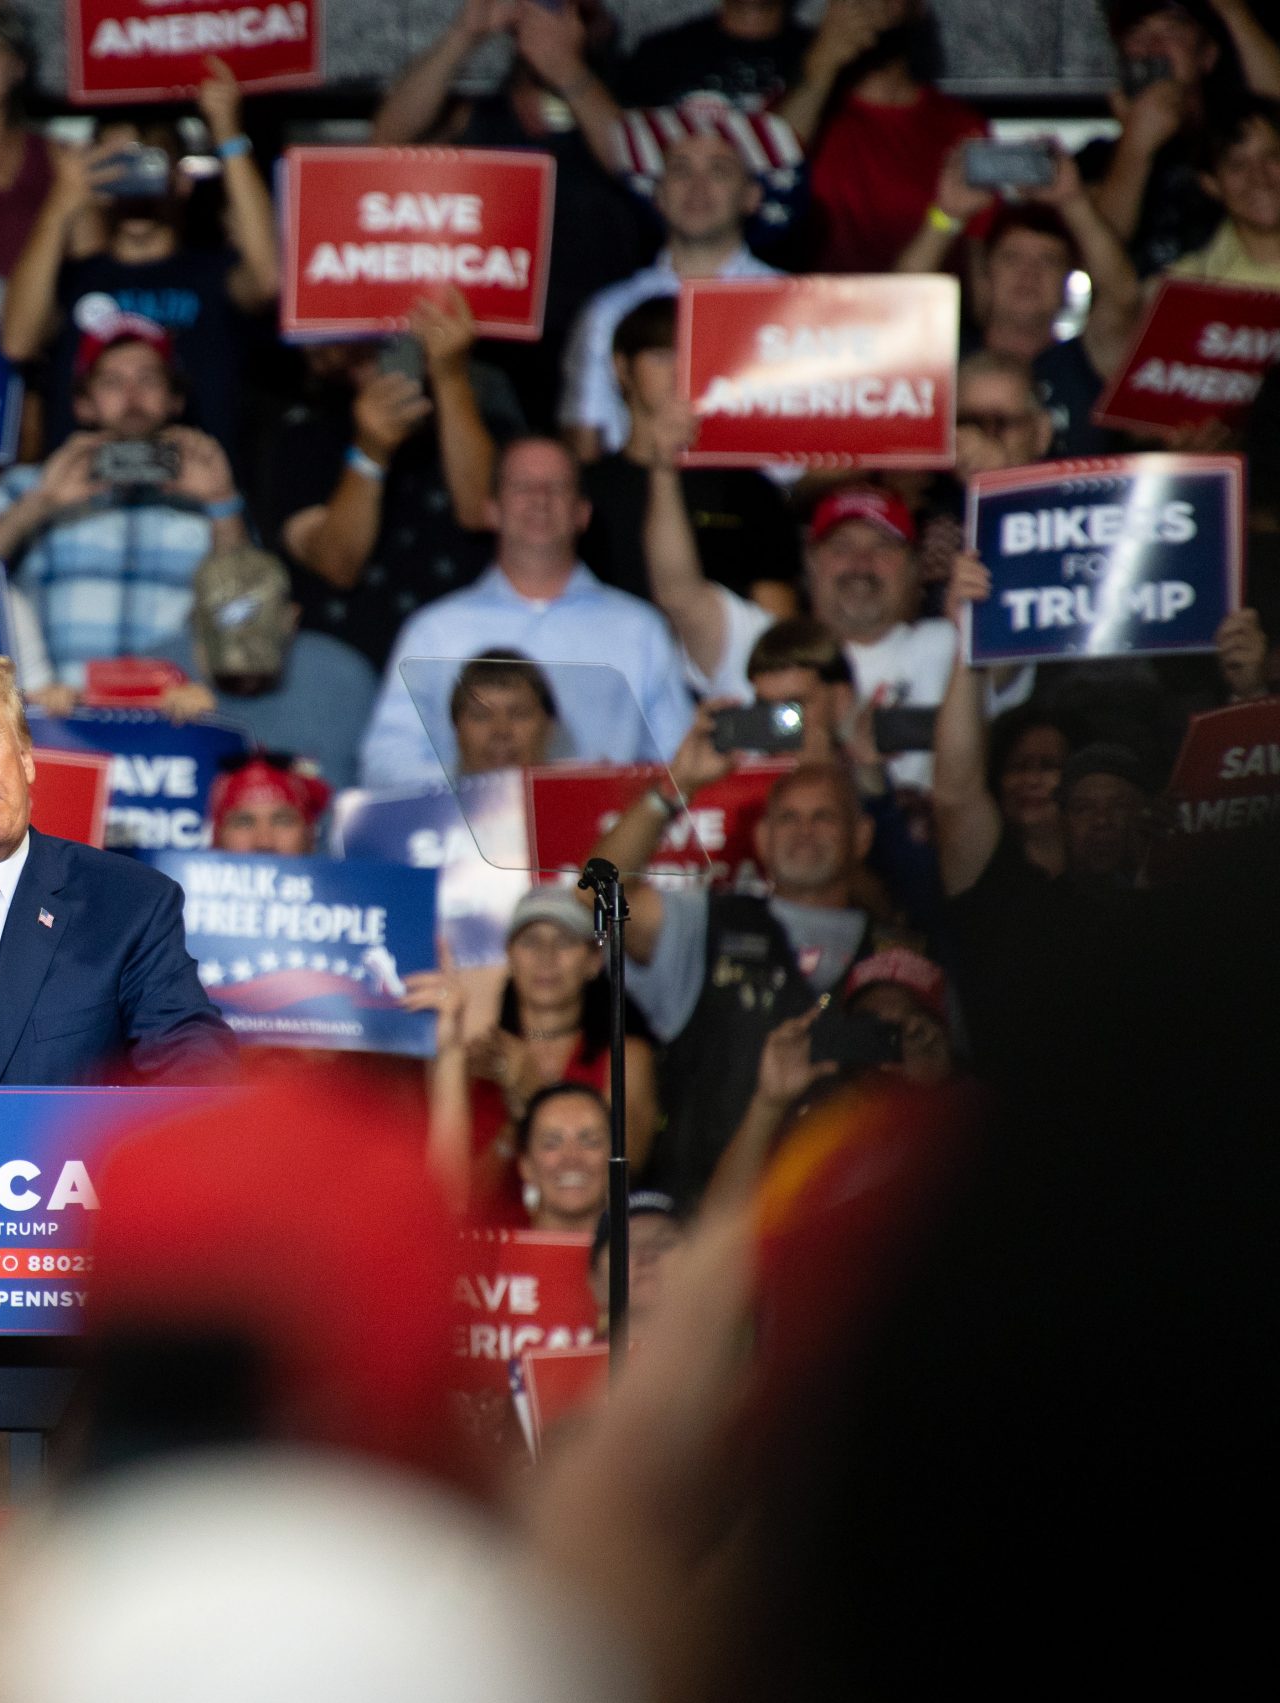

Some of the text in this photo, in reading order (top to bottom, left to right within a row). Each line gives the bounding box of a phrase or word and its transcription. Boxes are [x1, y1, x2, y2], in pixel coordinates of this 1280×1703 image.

[89, 2, 308, 58] AMERICA!
[357, 190, 484, 235] SAVE
[304, 241, 532, 291] AMERICA!
[698, 376, 936, 418] AMERICA!
[183, 859, 279, 899] WALK
[266, 903, 390, 946] PEOPLE
